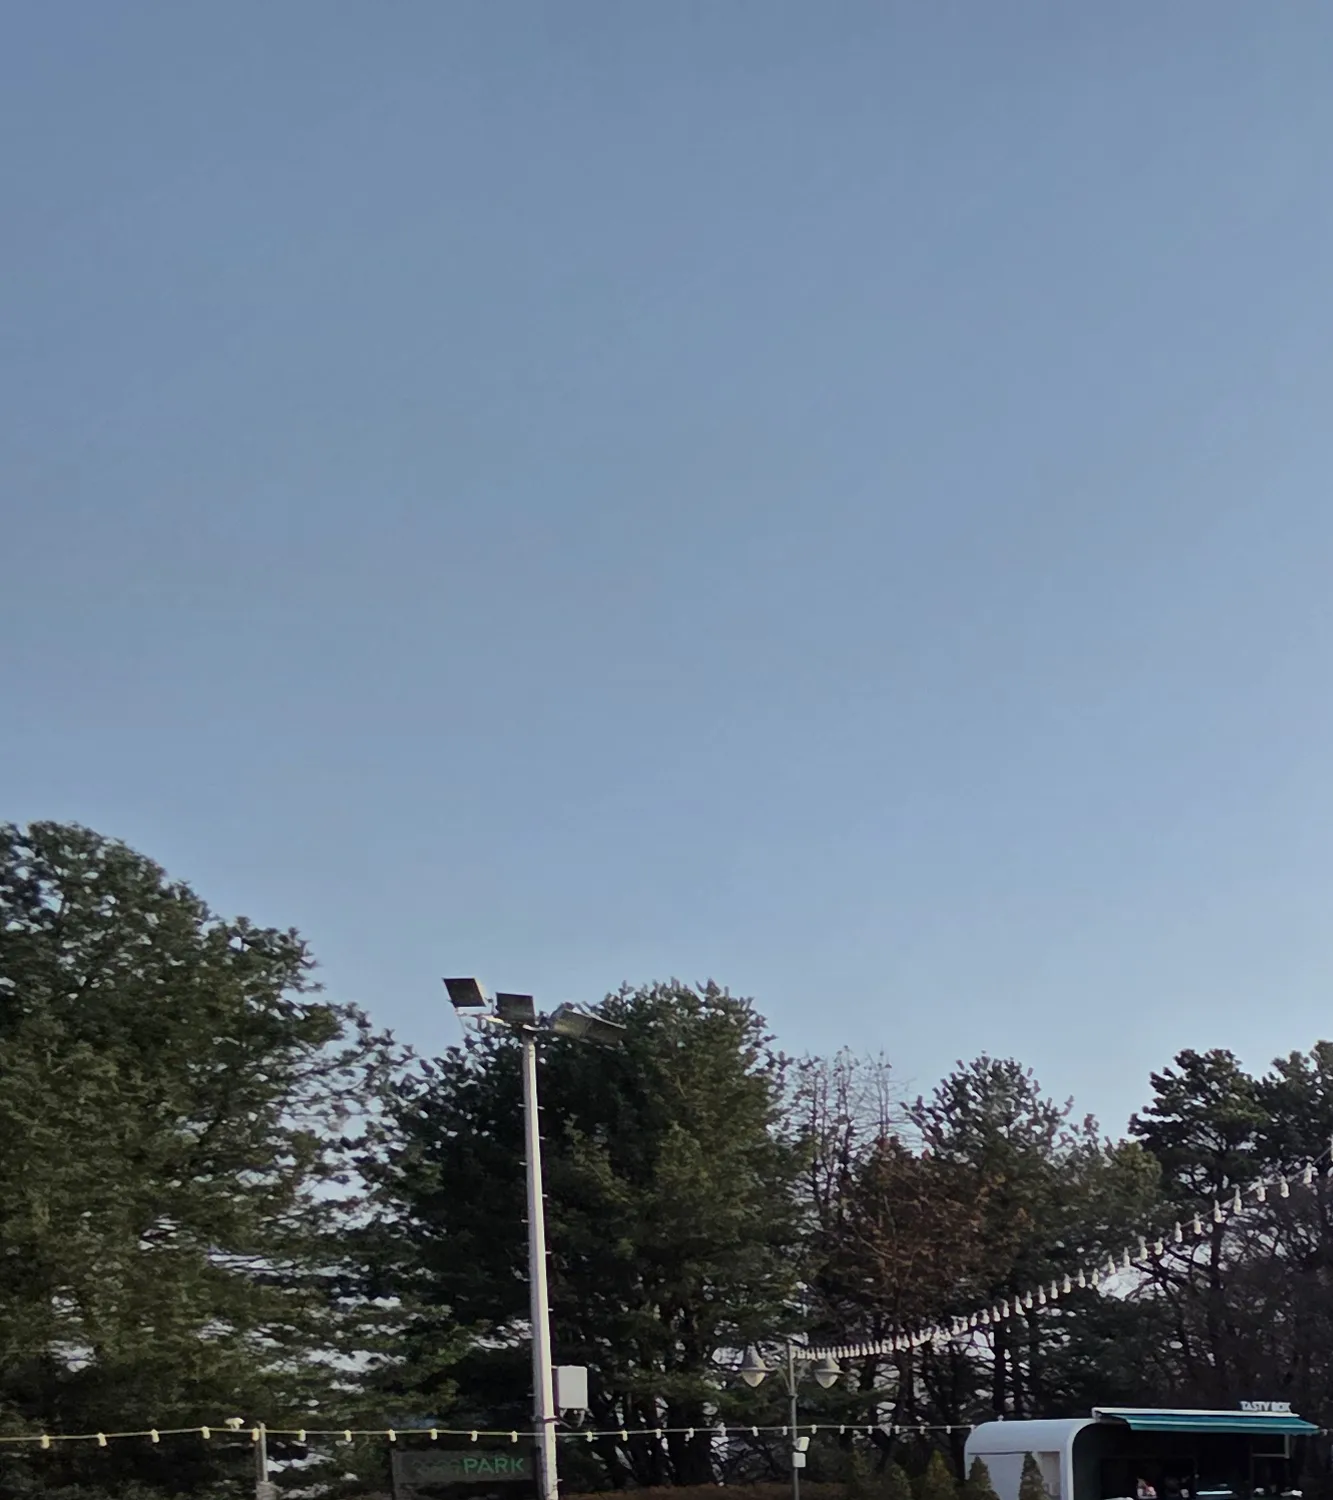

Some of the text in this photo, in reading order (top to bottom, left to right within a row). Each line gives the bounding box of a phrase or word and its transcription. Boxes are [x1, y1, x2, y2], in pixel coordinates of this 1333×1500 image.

[1240, 1401, 1291, 1412] TASTY BOX
[463, 1457, 524, 1474] PARK
